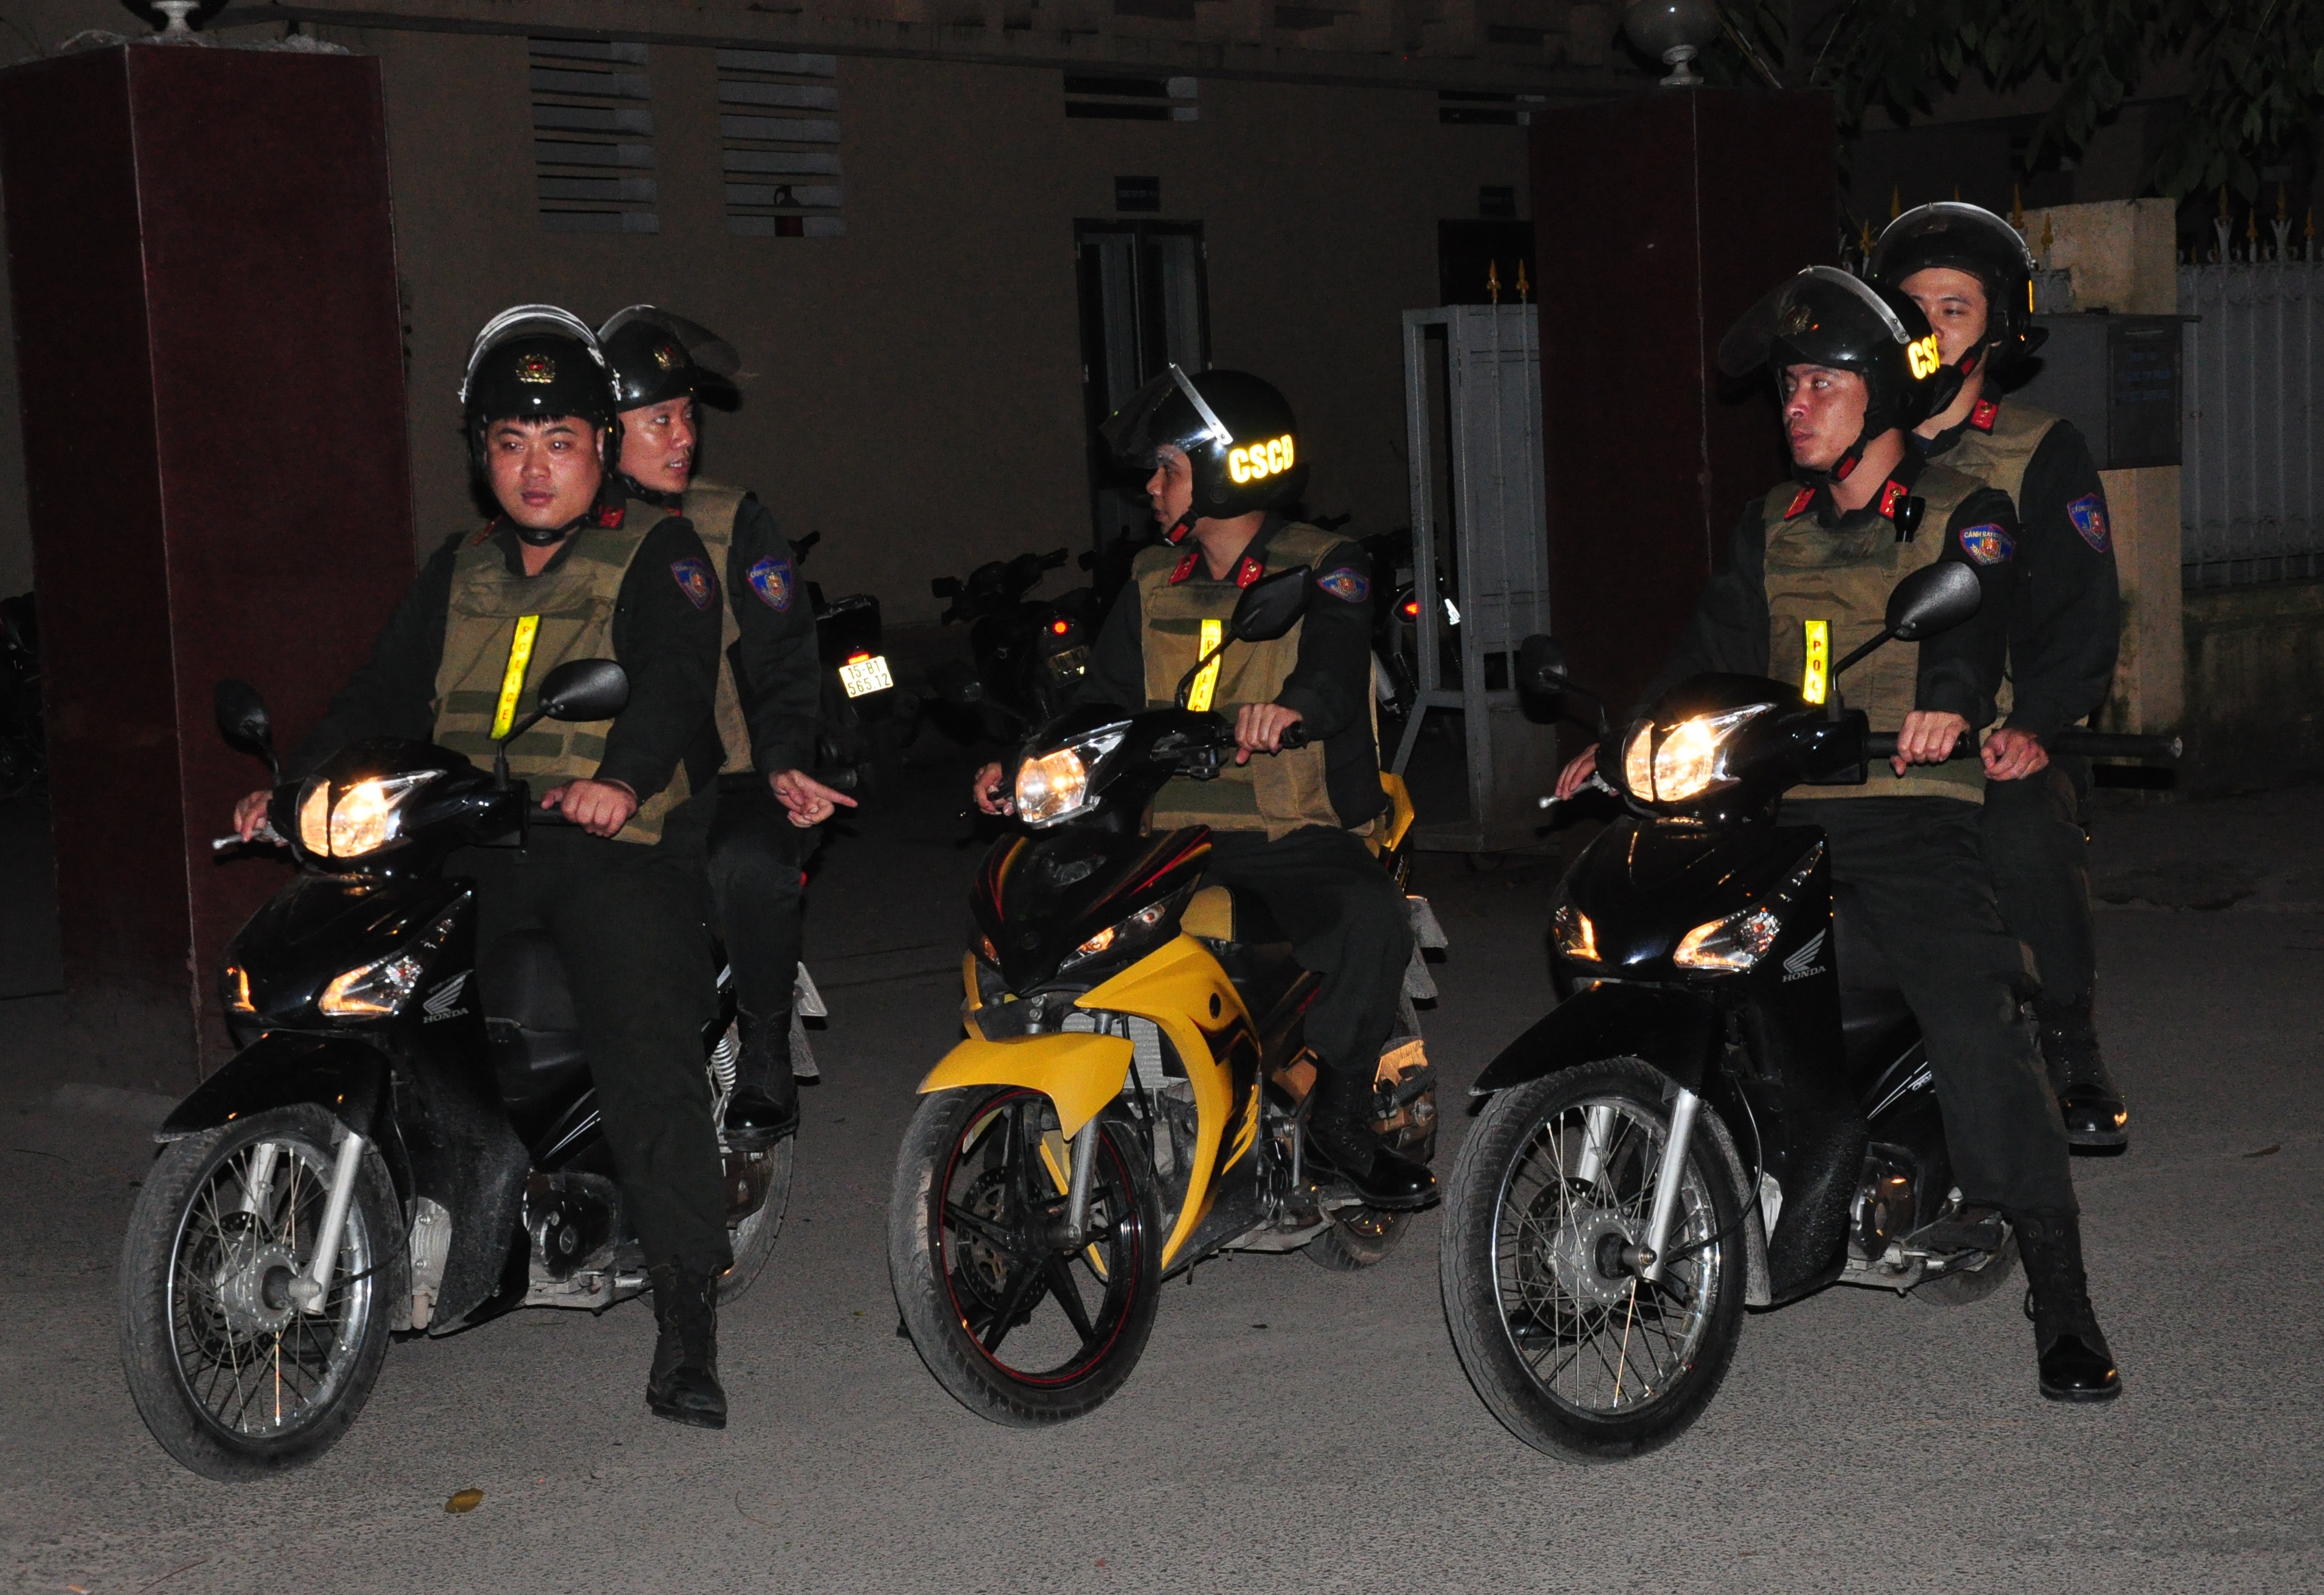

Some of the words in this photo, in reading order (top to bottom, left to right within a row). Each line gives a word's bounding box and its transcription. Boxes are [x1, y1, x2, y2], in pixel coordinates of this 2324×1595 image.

[502, 626, 531, 720] POLICE
[848, 660, 880, 680] 15-B1
[848, 673, 890, 695] 565.12
[1782, 965, 1826, 983] HONDA
[423, 1007, 469, 1024] HONDA
